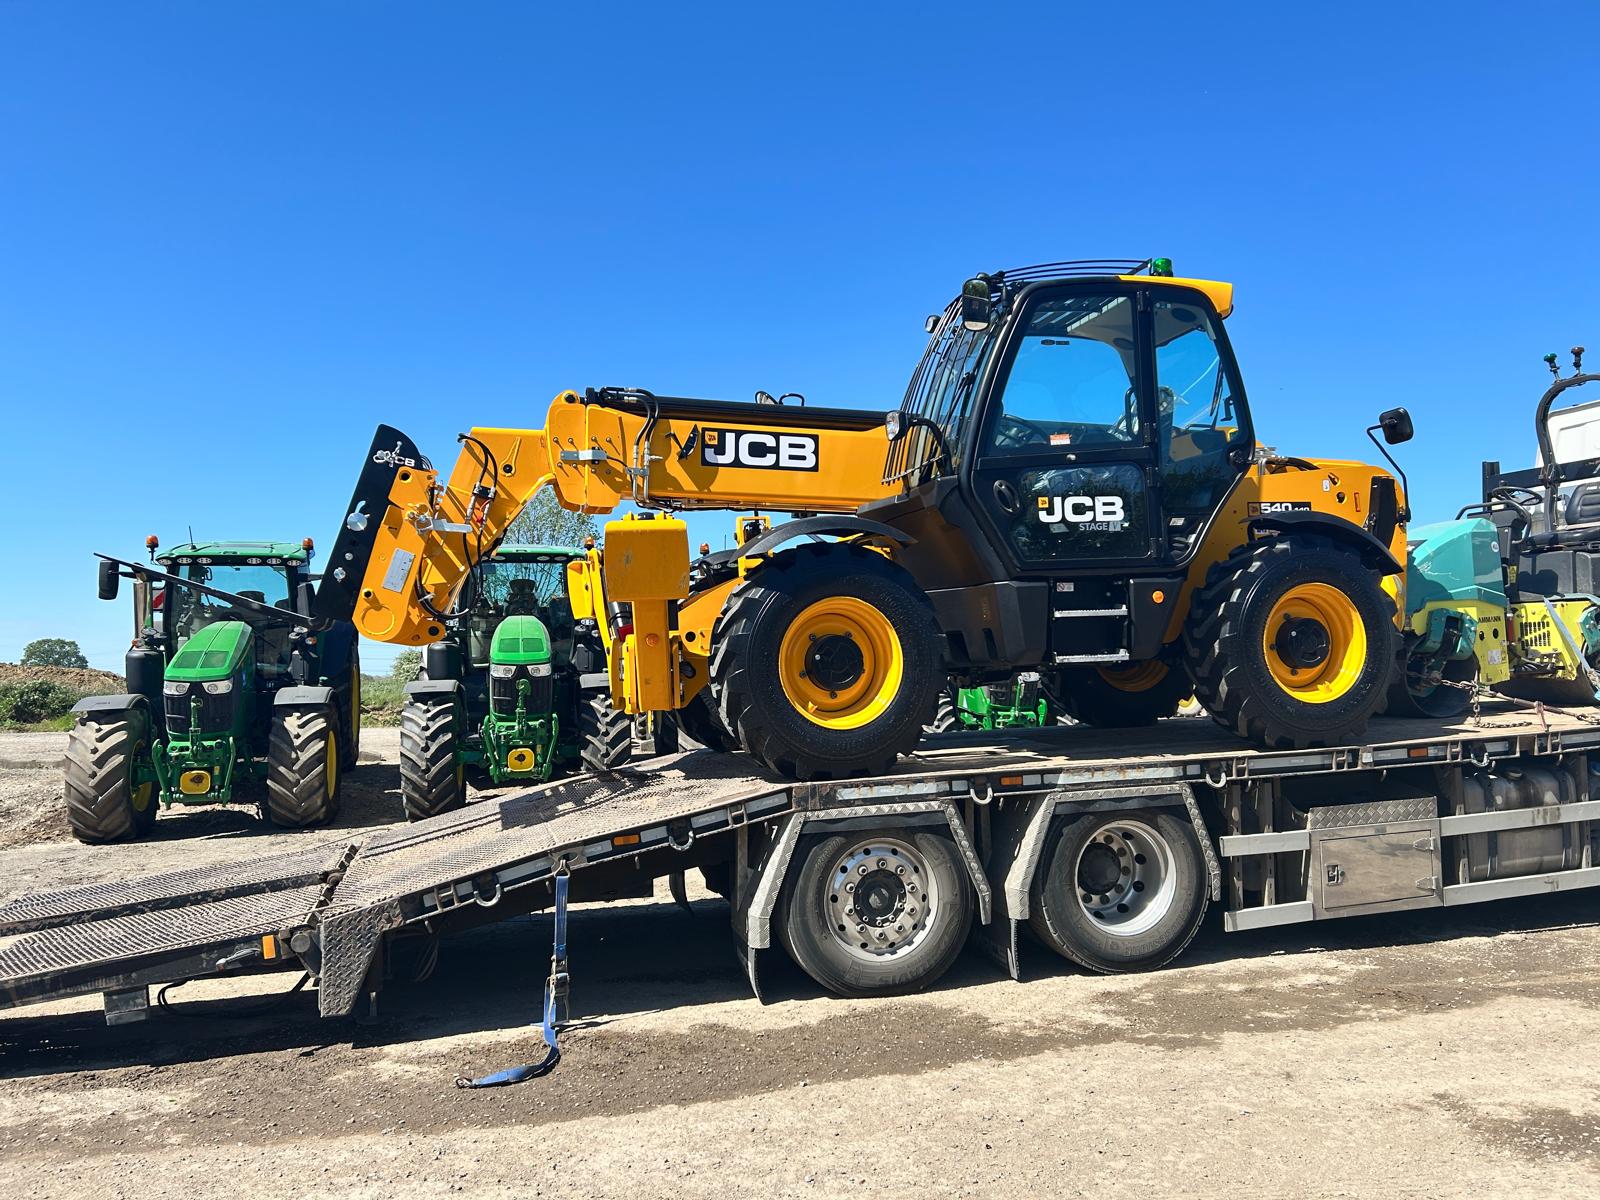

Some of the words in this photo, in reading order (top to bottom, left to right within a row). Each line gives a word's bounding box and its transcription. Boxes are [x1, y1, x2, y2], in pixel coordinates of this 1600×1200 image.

[704, 432, 816, 468] JCB
[1038, 496, 1125, 523] JCB
[1079, 522, 1108, 531] STAGE
